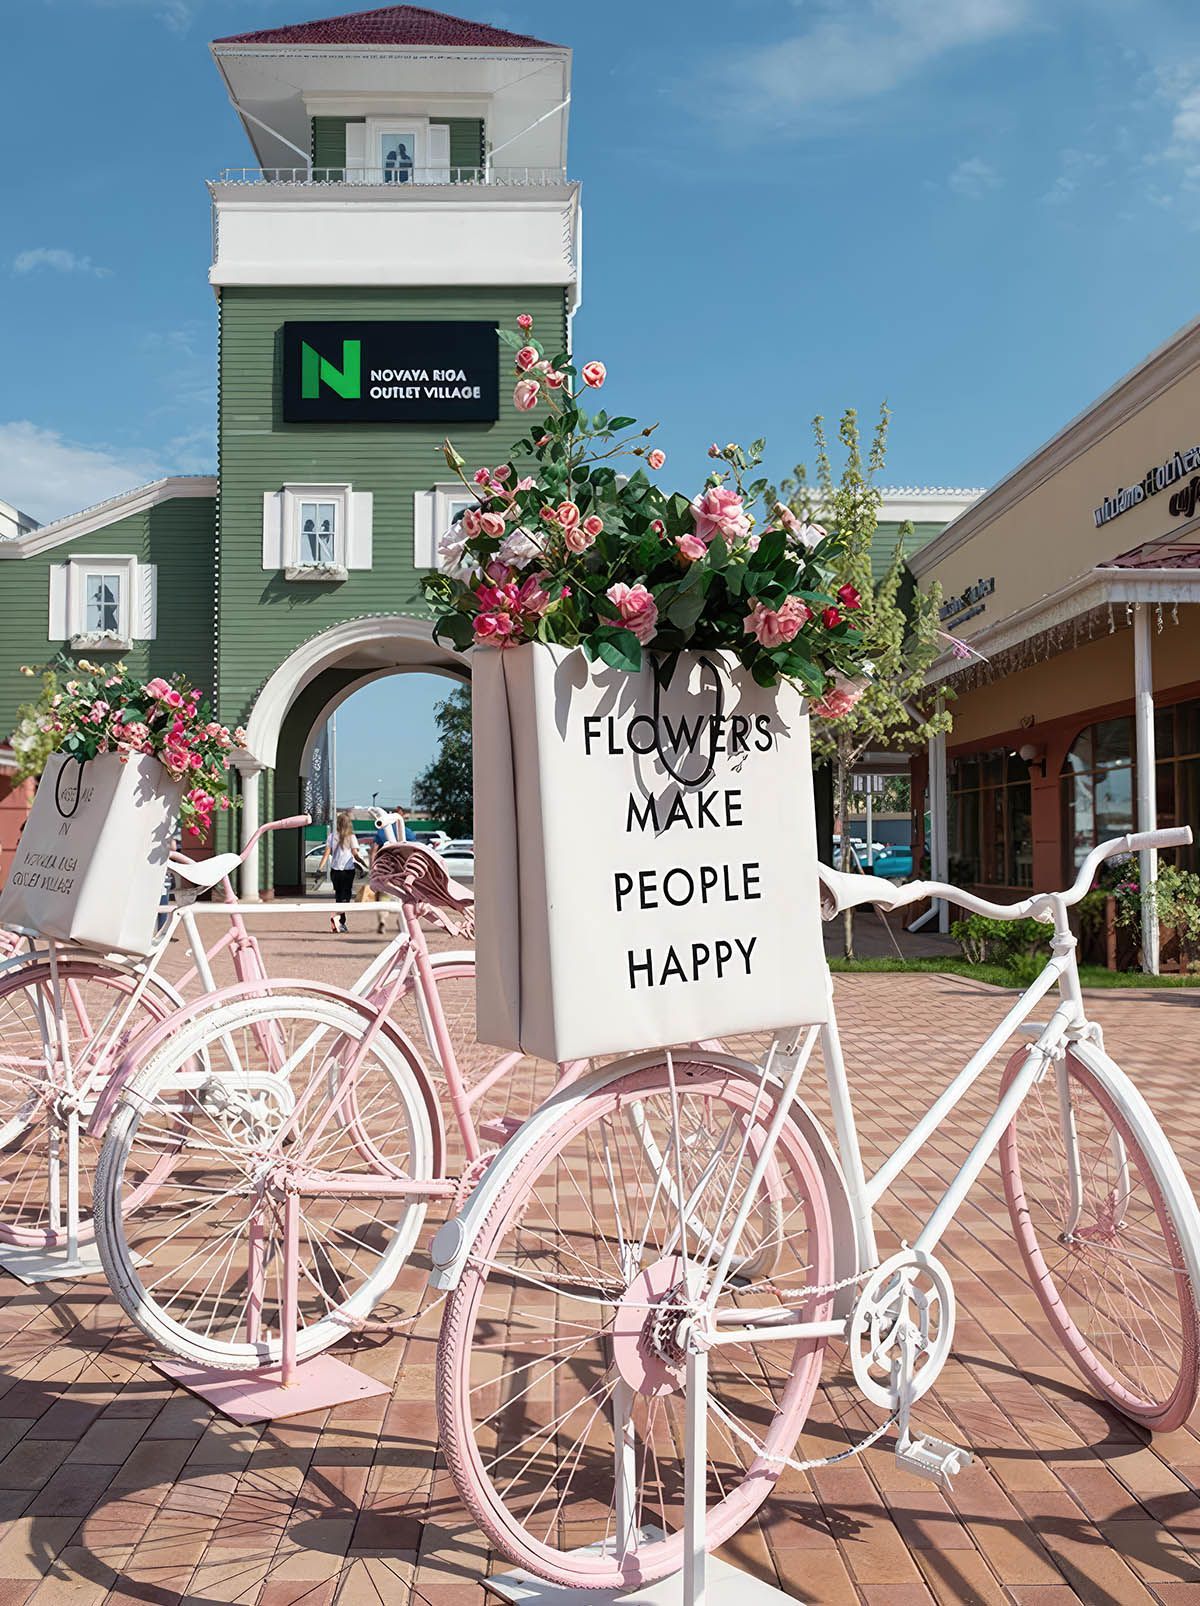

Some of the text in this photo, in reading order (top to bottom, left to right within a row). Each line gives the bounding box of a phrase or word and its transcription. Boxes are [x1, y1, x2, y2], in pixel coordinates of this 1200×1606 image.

[369, 386, 481, 399] OUTLET VILLAGE
[370, 369, 430, 382] NOVAYA
[584, 714, 773, 755] FLOWERS
[626, 790, 743, 832] MAKE
[614, 862, 762, 912] PEOPLE
[627, 936, 757, 989] HAPPY
